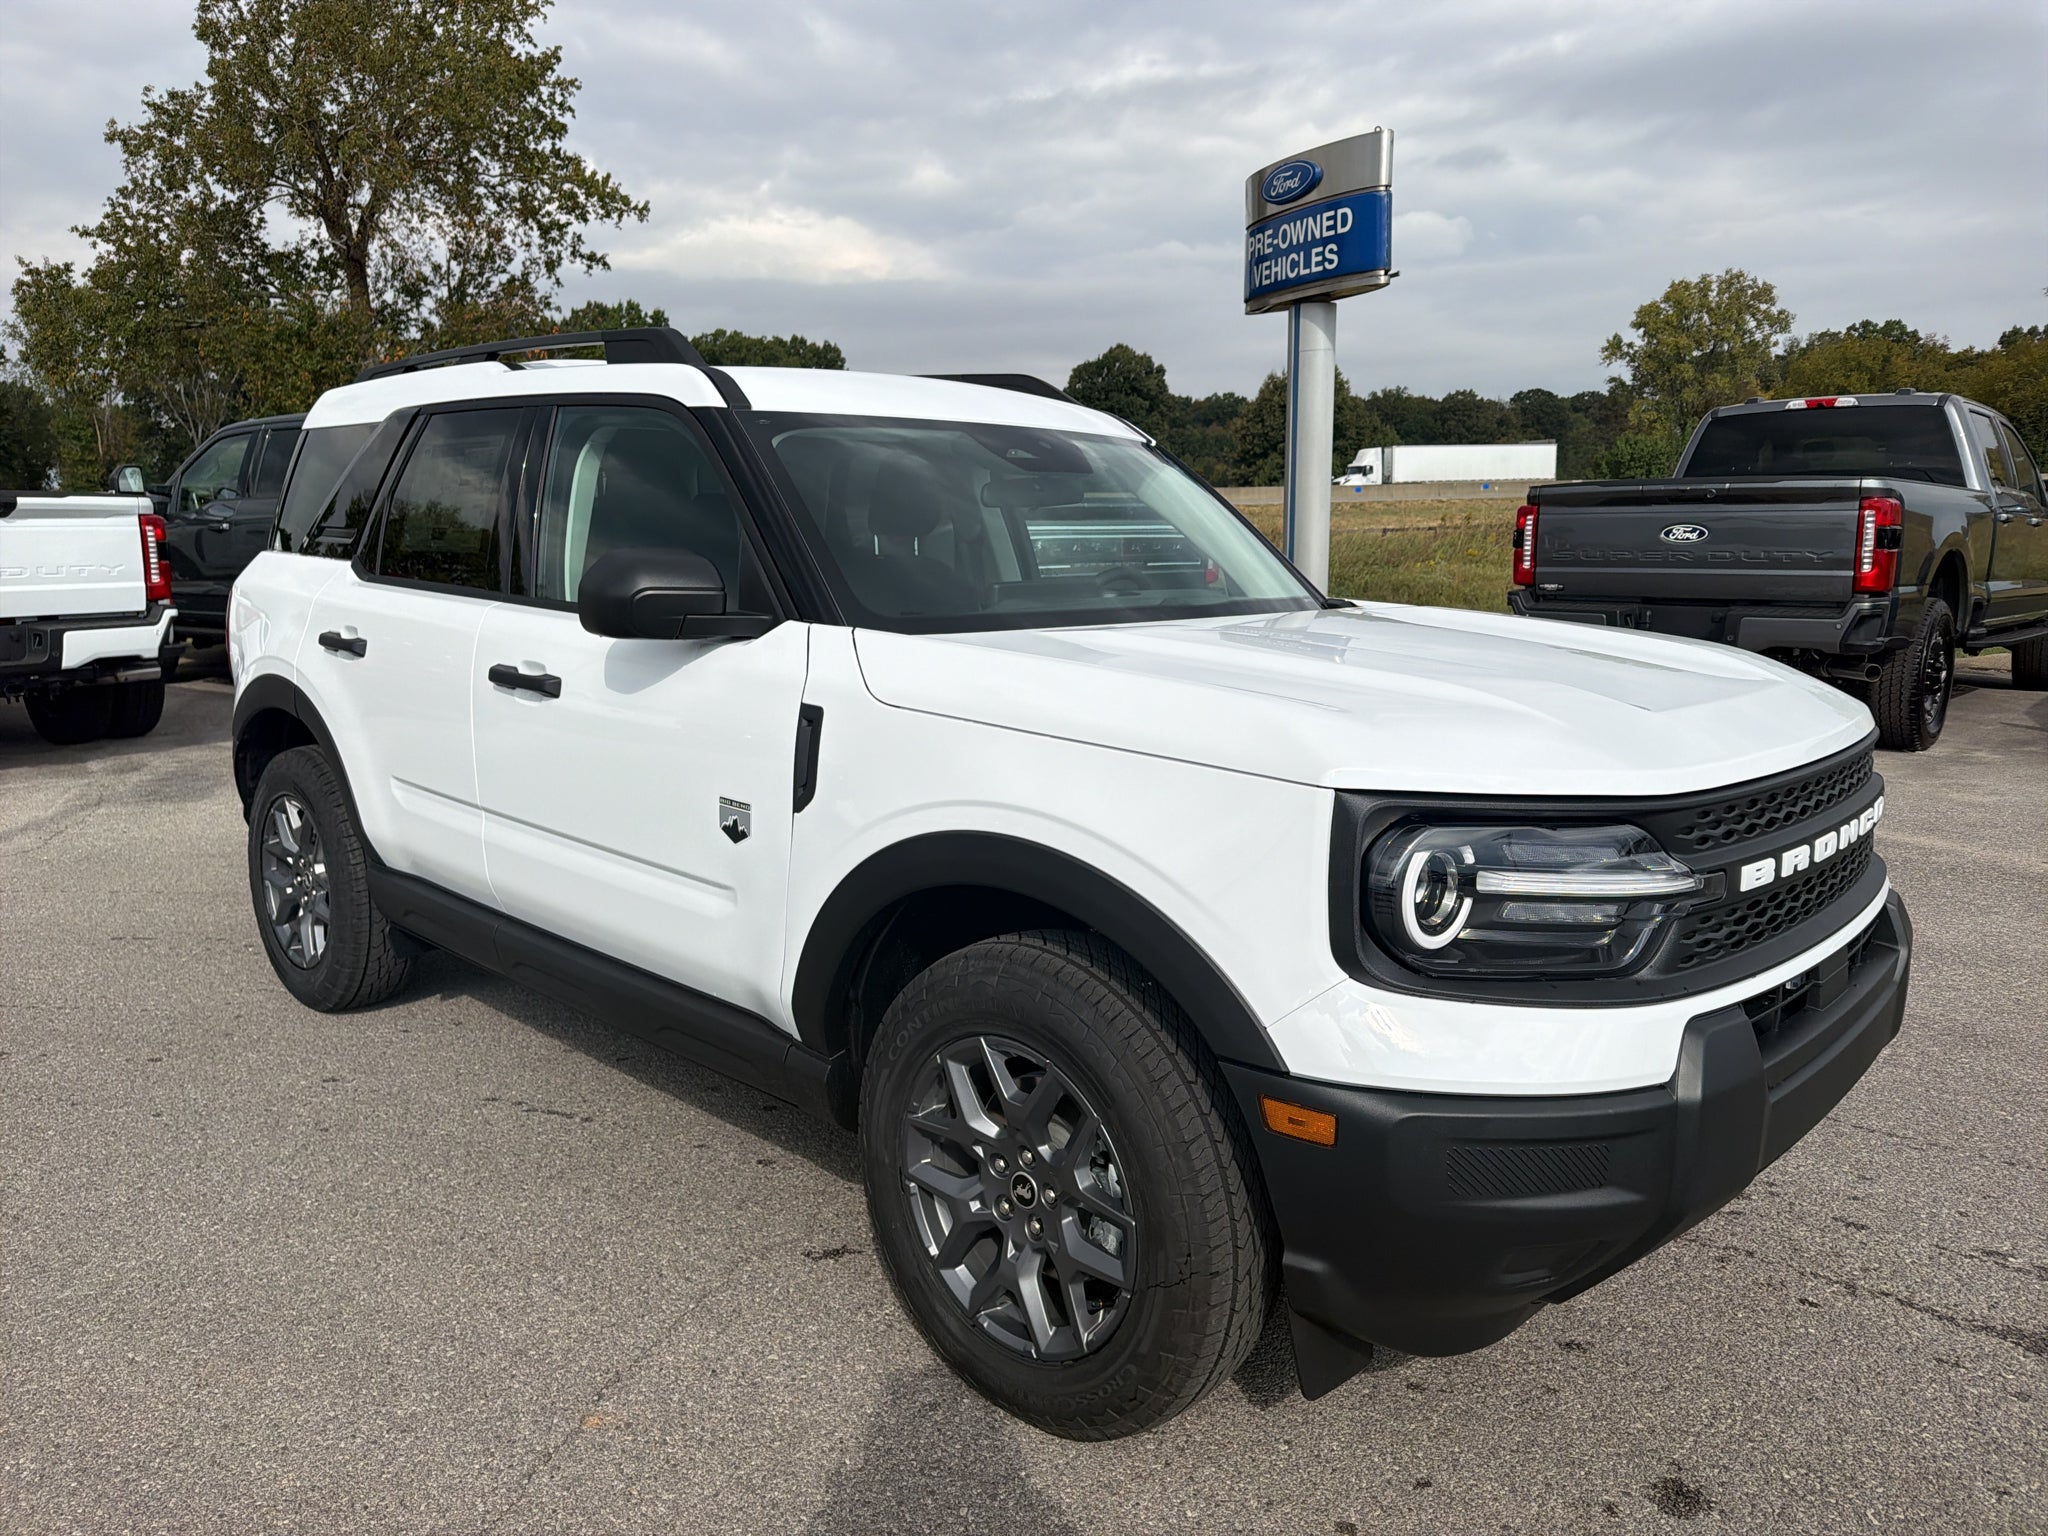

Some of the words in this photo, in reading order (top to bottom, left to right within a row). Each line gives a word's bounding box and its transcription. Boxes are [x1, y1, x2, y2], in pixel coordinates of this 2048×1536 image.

[1270, 170, 1302, 197] Ford
[1249, 207, 1354, 260] PRE-OWNED
[1253, 243, 1339, 288] VEHICLES
[1668, 526, 1700, 540] Ford
[1551, 550, 1695, 562] SUPER
[1707, 550, 1834, 563] DUTY
[0, 563, 126, 579] DUTY
[1740, 795, 1885, 892] BRONCO
